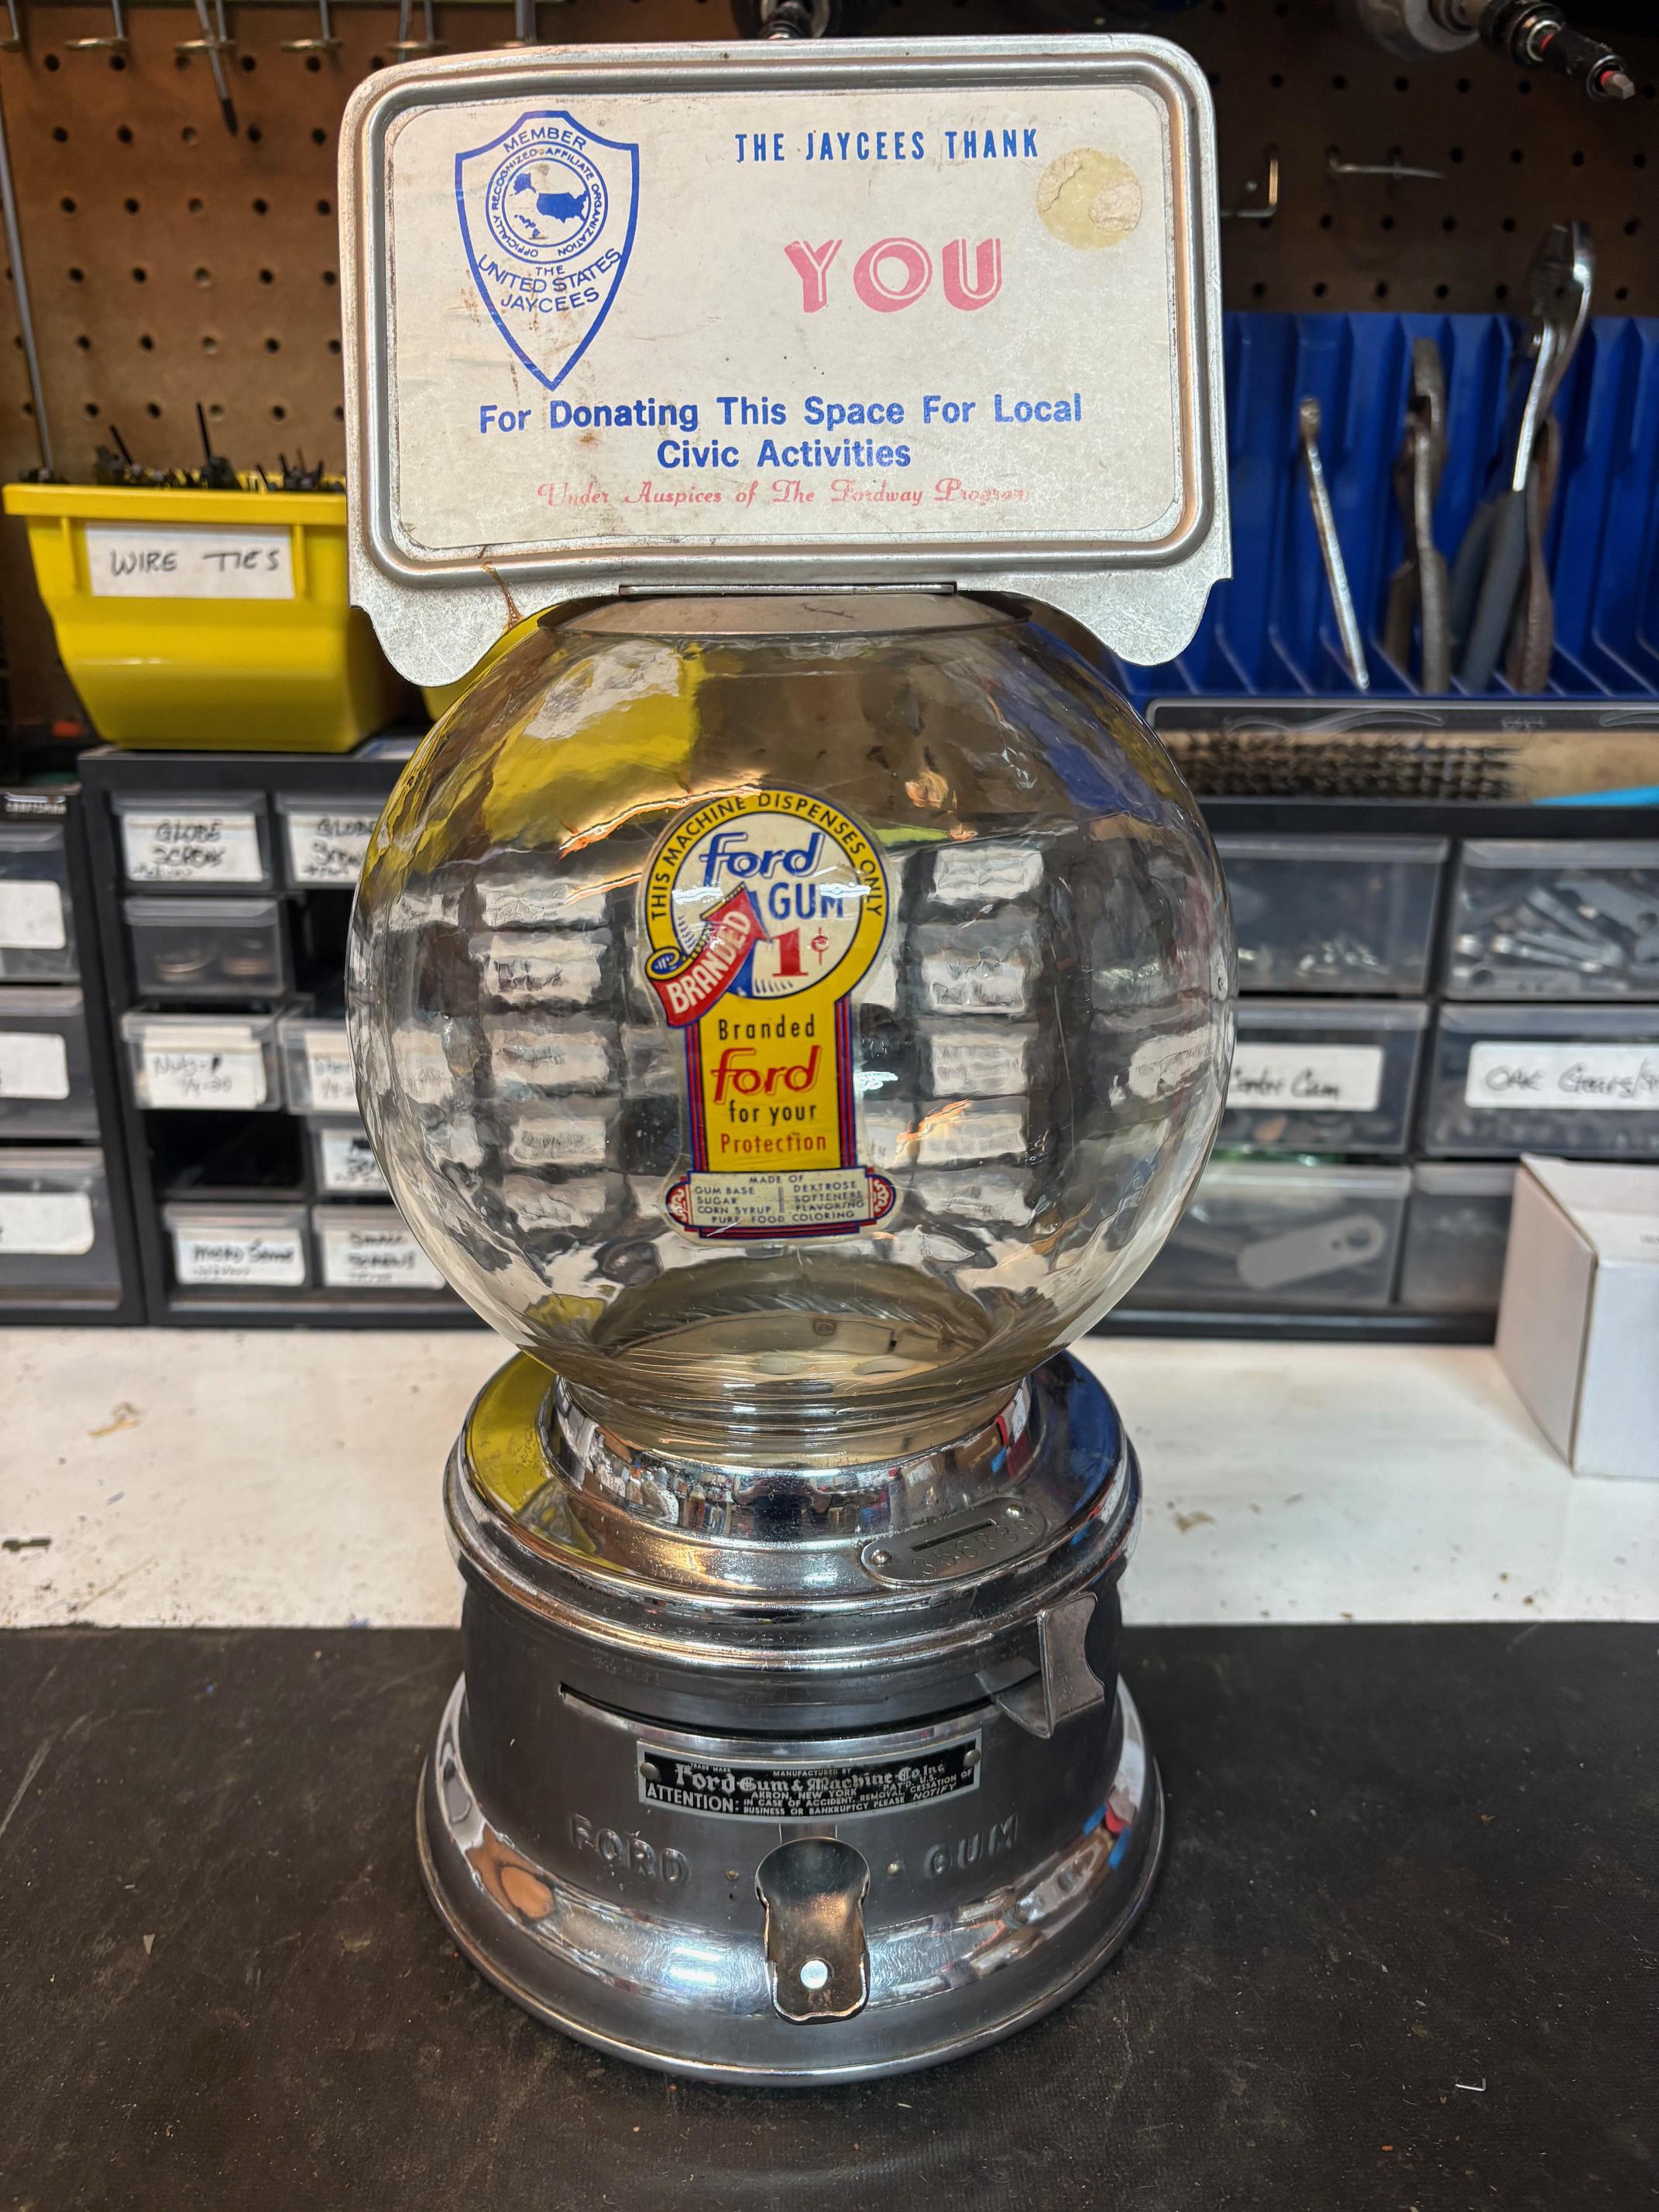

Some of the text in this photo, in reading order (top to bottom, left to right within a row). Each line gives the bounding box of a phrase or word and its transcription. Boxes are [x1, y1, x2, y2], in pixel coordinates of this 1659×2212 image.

[503, 127, 586, 153] MEMBER
[735, 129, 1039, 163] THE JAYCEES THANK
[491, 147, 603, 257] OFFICIALLY RECOGNIZED AFFILIATE ORGANIZATION
[477, 248, 621, 293] UNITED STATES
[535, 265, 565, 276] THE
[784, 237, 1002, 313] YOU
[500, 287, 599, 313] JAYCEES
[479, 393, 1082, 433] For Donating This Space For Local
[657, 438, 912, 469] Civic Activities
[538, 483, 609, 507] Under
[623, 481, 723, 507] Auspices
[735, 480, 760, 508] of
[771, 479, 816, 504] The
[109, 548, 178, 577] WIRE
[651, 792, 883, 922] THIS MACHINE DISPENSES ONLY
[768, 882, 843, 921] GUM
[666, 910, 753, 1015] BRANDED
[719, 1014, 815, 1040] Branded
[729, 1100, 817, 1125] for your
[721, 1132, 826, 1154] Protection
[695, 1186, 755, 1195] GUM BASE
[750, 1176, 781, 1184] MADE
[793, 1181, 857, 1193] DEXTROSE
[696, 1196, 738, 1204] SUGAR
[698, 1206, 729, 1214] CORN
[795, 1200, 865, 1212] FLAVORING
[751, 1215, 785, 1224] FOOD
[792, 1211, 855, 1221] COLORING
[675, 1763, 736, 1794] Ford
[740, 1777, 789, 1791] Gum
[791, 1780, 803, 1791] &
[807, 1771, 893, 1792] Machine
[690, 1762, 709, 1771] TRADE
[773, 1768, 838, 1778] MANUFACTURED
[647, 1782, 739, 1813] ATTENTION:
[744, 1807, 785, 1815] BUSINESS
[809, 1802, 869, 1815] BANKRUPTCY
[874, 1796, 905, 1808] PLEASE
[912, 1781, 957, 1802] NOTIFY
[751, 1791, 792, 1800] AKRON,
[829, 1788, 857, 1798] YORK
[806, 1796, 856, 1807] ACCIDENT,
[860, 1790, 905, 1802] REMOVAL,
[910, 1774, 957, 1794] CESSATION
[960, 1768, 973, 1778] OF
[569, 1812, 691, 1884] FORD
[924, 1812, 1018, 1880] GUM
